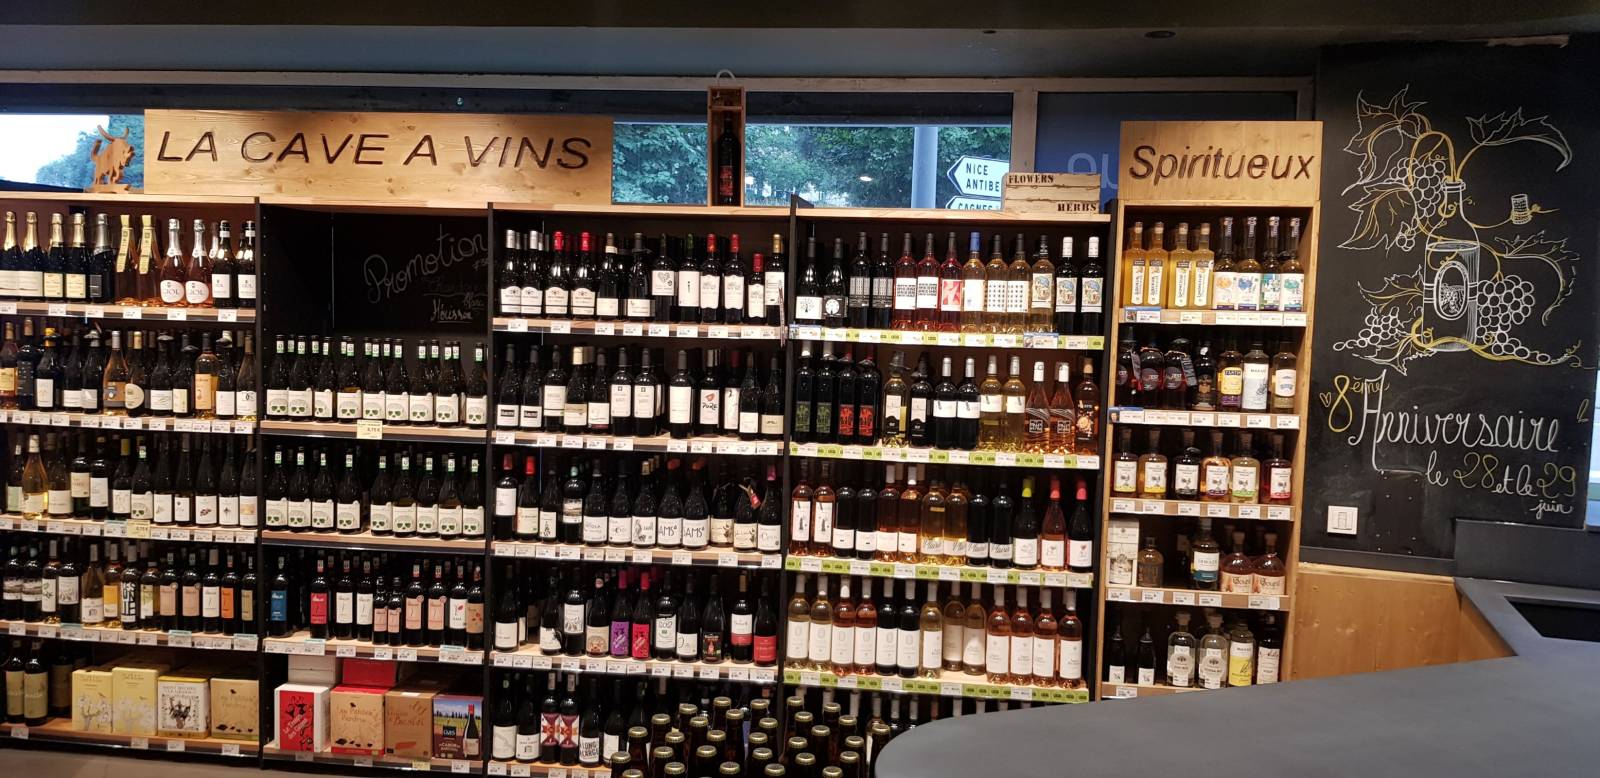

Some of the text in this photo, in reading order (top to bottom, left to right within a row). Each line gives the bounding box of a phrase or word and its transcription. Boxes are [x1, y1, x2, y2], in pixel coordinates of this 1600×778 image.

[157, 131, 593, 170] LA CAVE A VINS
[966, 162, 989, 175] NICE
[1129, 145, 1315, 185] Spiritueux
[1008, 173, 1054, 186] FLOWERS
[1057, 202, 1098, 213] HERBS
[363, 224, 488, 304] Promotion
[1348, 369, 1560, 462] Anniversaire
[1453, 452, 1499, 489] 28
[1537, 462, 1576, 499] 29
[1530, 498, 1574, 520] juin
